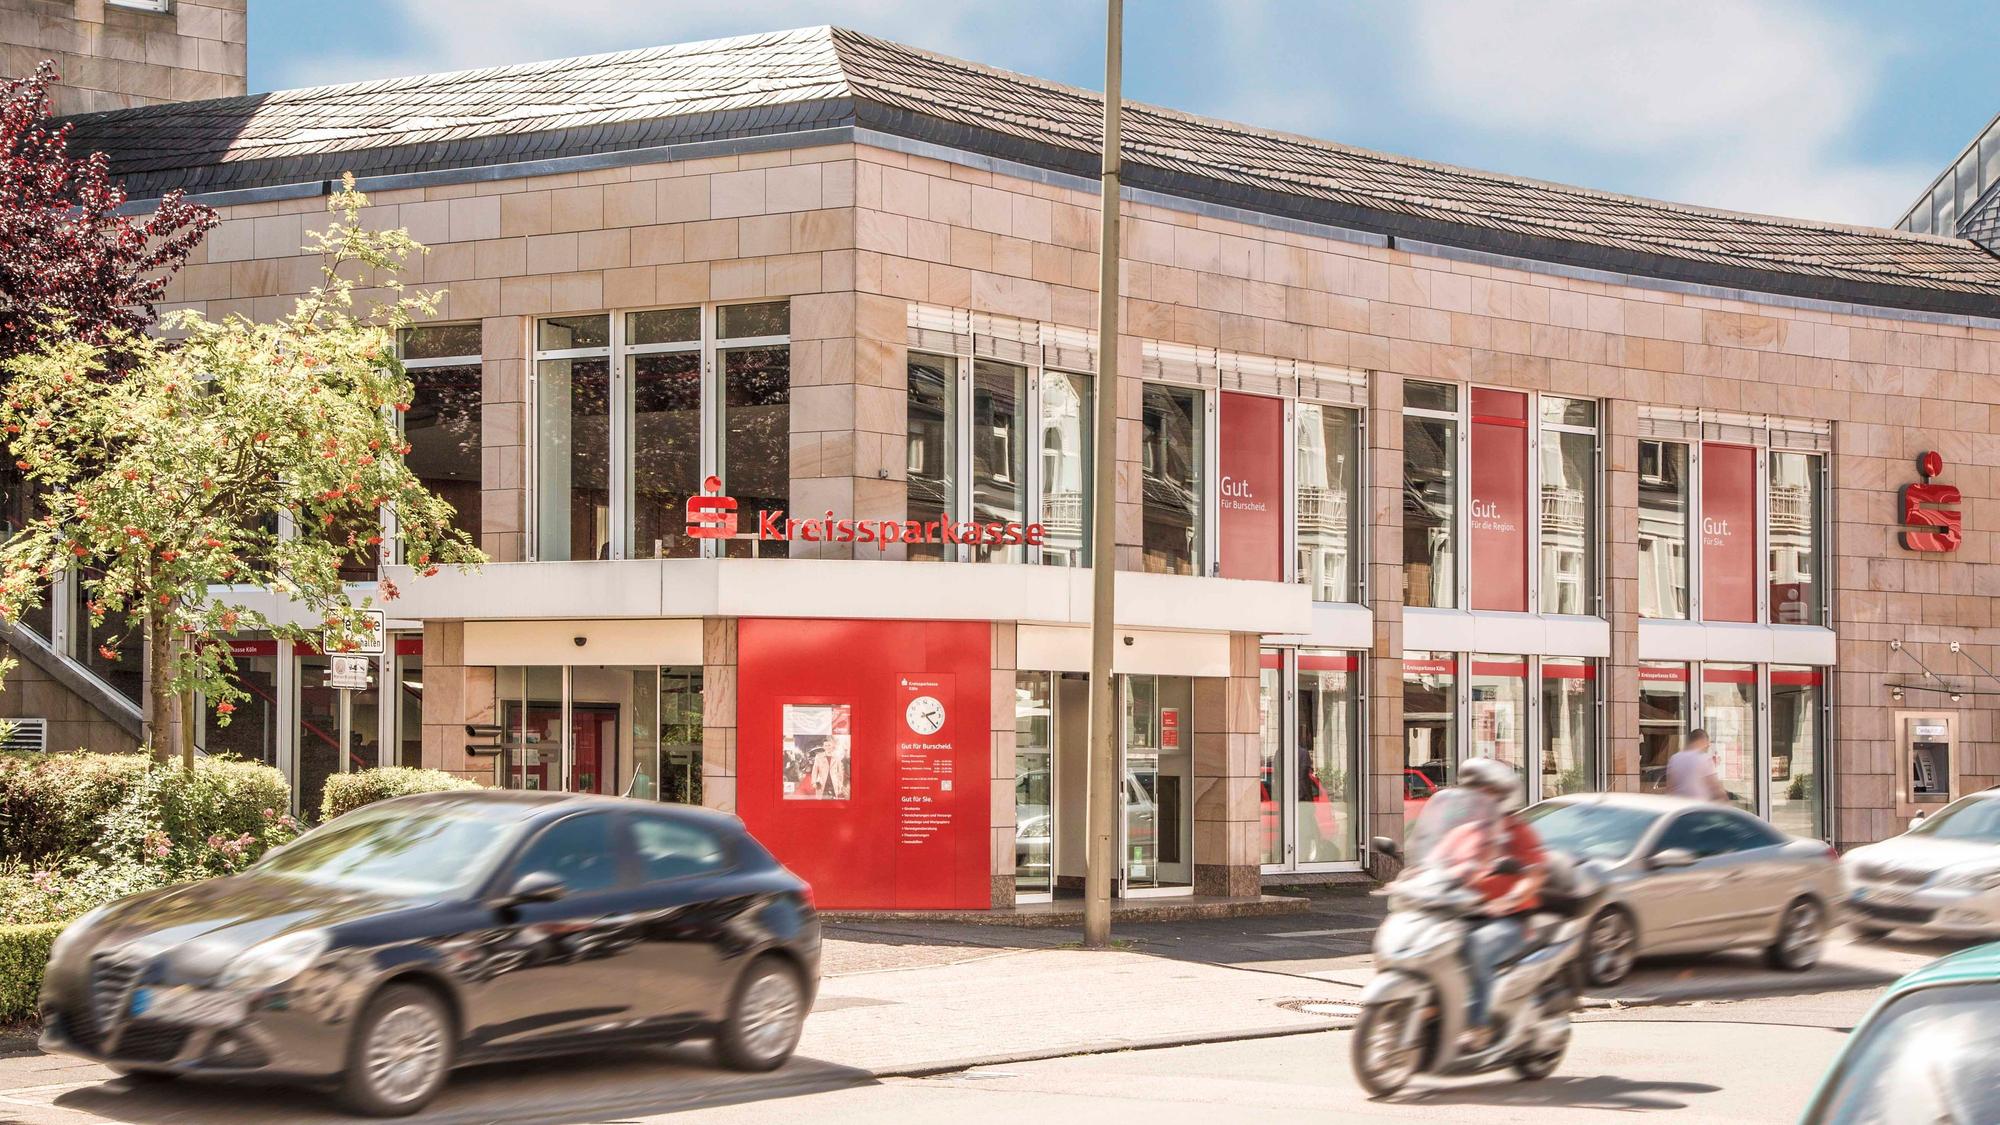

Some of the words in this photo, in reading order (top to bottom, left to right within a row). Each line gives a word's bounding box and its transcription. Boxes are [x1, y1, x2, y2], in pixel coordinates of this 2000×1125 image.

[1221, 476, 1253, 498] Gut.
[1221, 499, 1232, 509] Für
[1233, 501, 1267, 512] Burscheid.
[1471, 499, 1501, 519] Gut.
[759, 508, 1045, 551] Kreissparkasse
[1471, 520, 1481, 529] Für
[1493, 522, 1516, 533] Region.
[1703, 516, 1732, 536] Gut.
